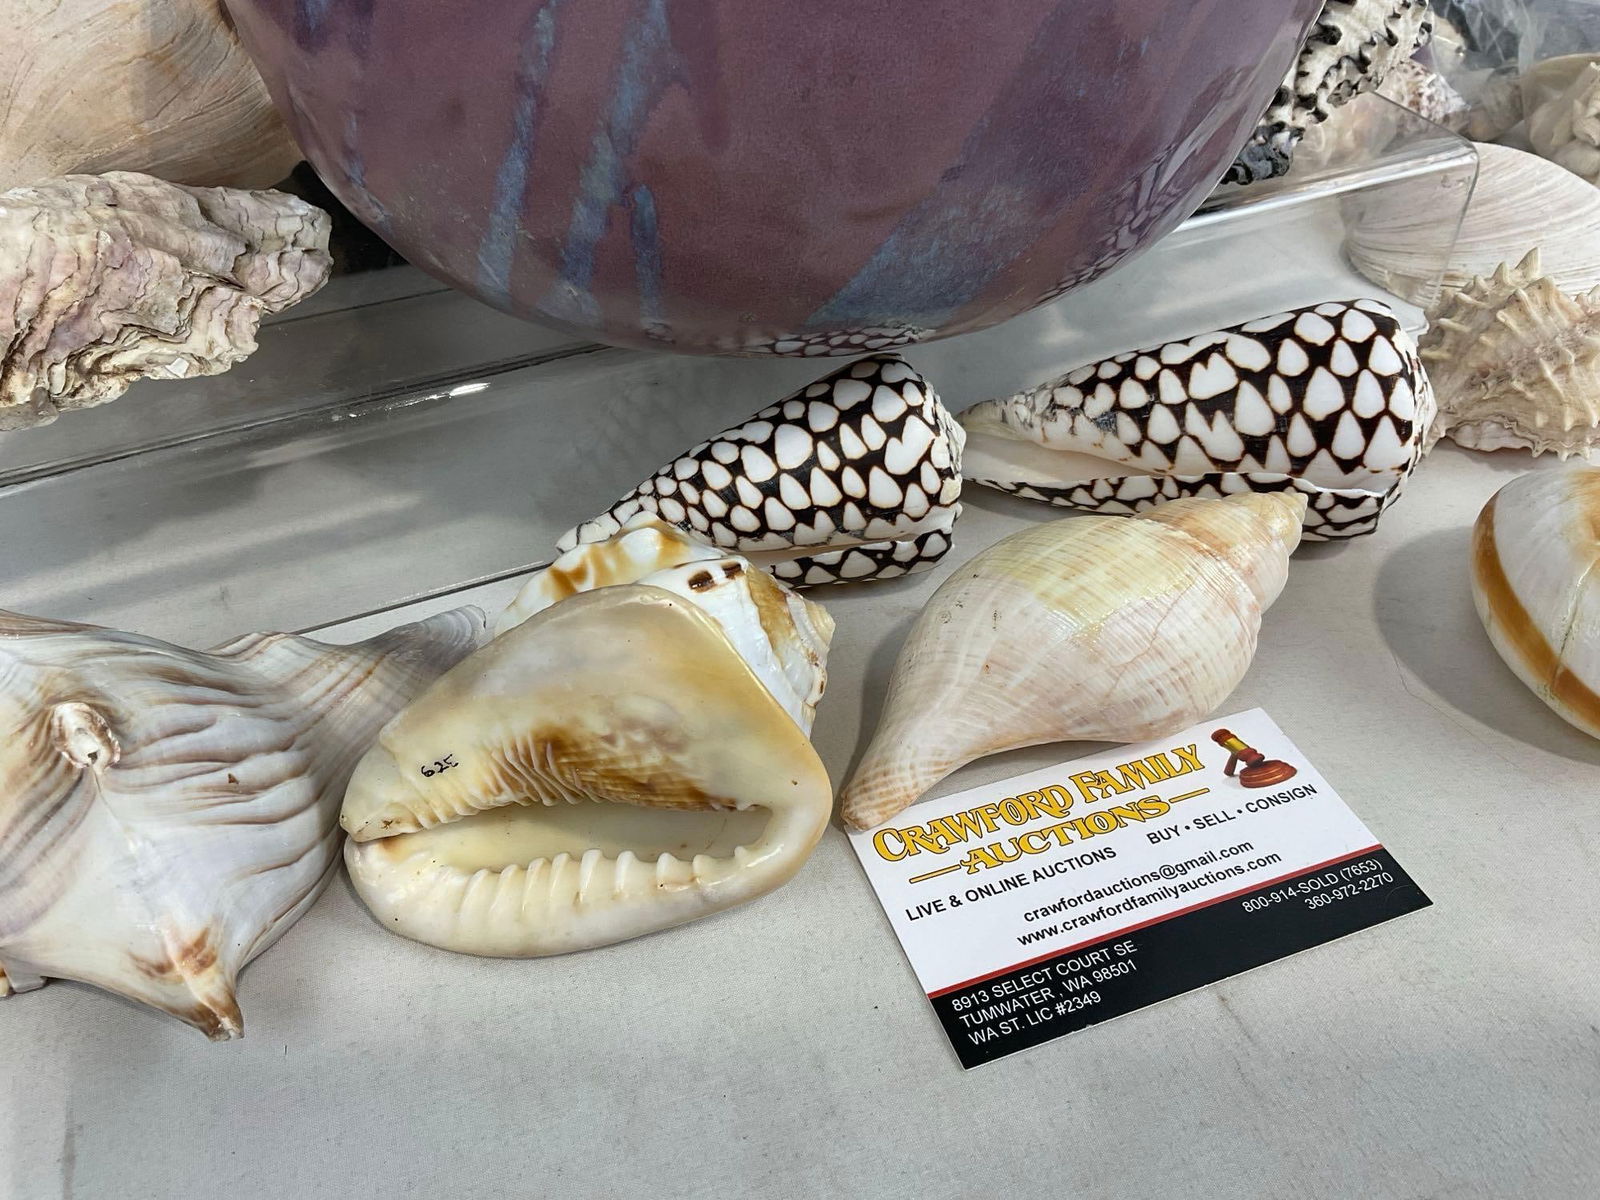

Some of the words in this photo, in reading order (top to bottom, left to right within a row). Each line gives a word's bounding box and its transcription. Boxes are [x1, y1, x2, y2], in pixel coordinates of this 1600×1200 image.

[873, 784, 1074, 862] CRAWFORD
[1069, 744, 1205, 803] FAMILY
[960, 795, 1171, 875] AUCTIONS
[1146, 825, 1181, 845] BUY
[1193, 810, 1236, 830] SELL
[1245, 784, 1318, 814] CONSIGN
[905, 899, 947, 921] LIVE
[949, 894, 963, 908] &
[965, 873, 1030, 902] ONLINE
[1033, 846, 1117, 883] AUCTIONS
[1017, 851, 1282, 946] www.crawfordfamilyauctions.com
[1023, 840, 1254, 923] crawfordauctions@gmail.com
[1242, 872, 1340, 913] 800-914-SOLD
[1339, 858, 1383, 883] (7653)
[1304, 871, 1394, 911] 360-972-2270
[951, 990, 990, 1012] 8913
[991, 968, 1054, 998] SELECT
[1055, 948, 1111, 976] COURT
[1113, 940, 1138, 956] SE
[959, 987, 1055, 1028] TUMWATER
[1063, 975, 1093, 993] WA
[1092, 958, 1138, 983] 98501
[967, 1026, 999, 1046] WA
[998, 1016, 1026, 1036] ST.
[1027, 1006, 1054, 1026] LIC
[1054, 990, 1102, 1016] #2349
